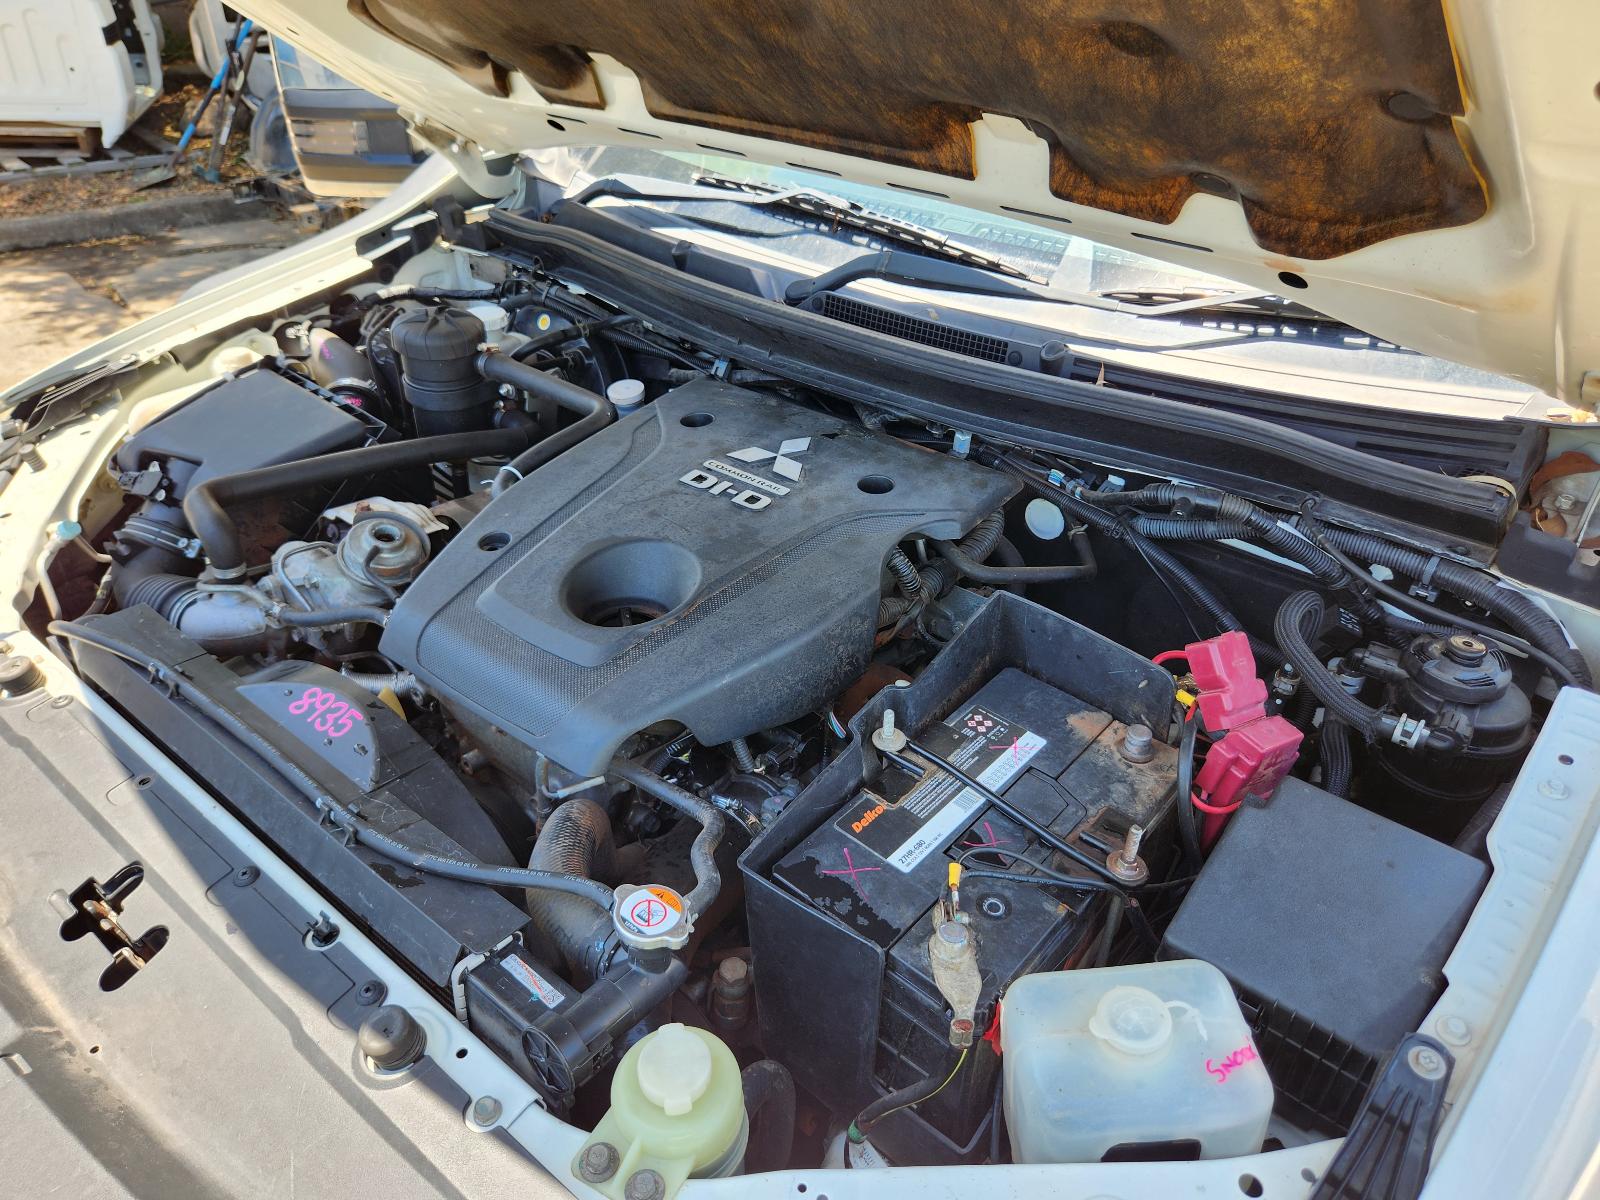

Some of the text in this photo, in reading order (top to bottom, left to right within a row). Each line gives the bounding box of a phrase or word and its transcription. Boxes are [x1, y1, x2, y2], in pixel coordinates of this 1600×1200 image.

[679, 469, 772, 511] DI-D
[707, 461, 782, 494] COMMON RAIL
[288, 687, 364, 737] 8935
[898, 839, 926, 864] 27HR-680
